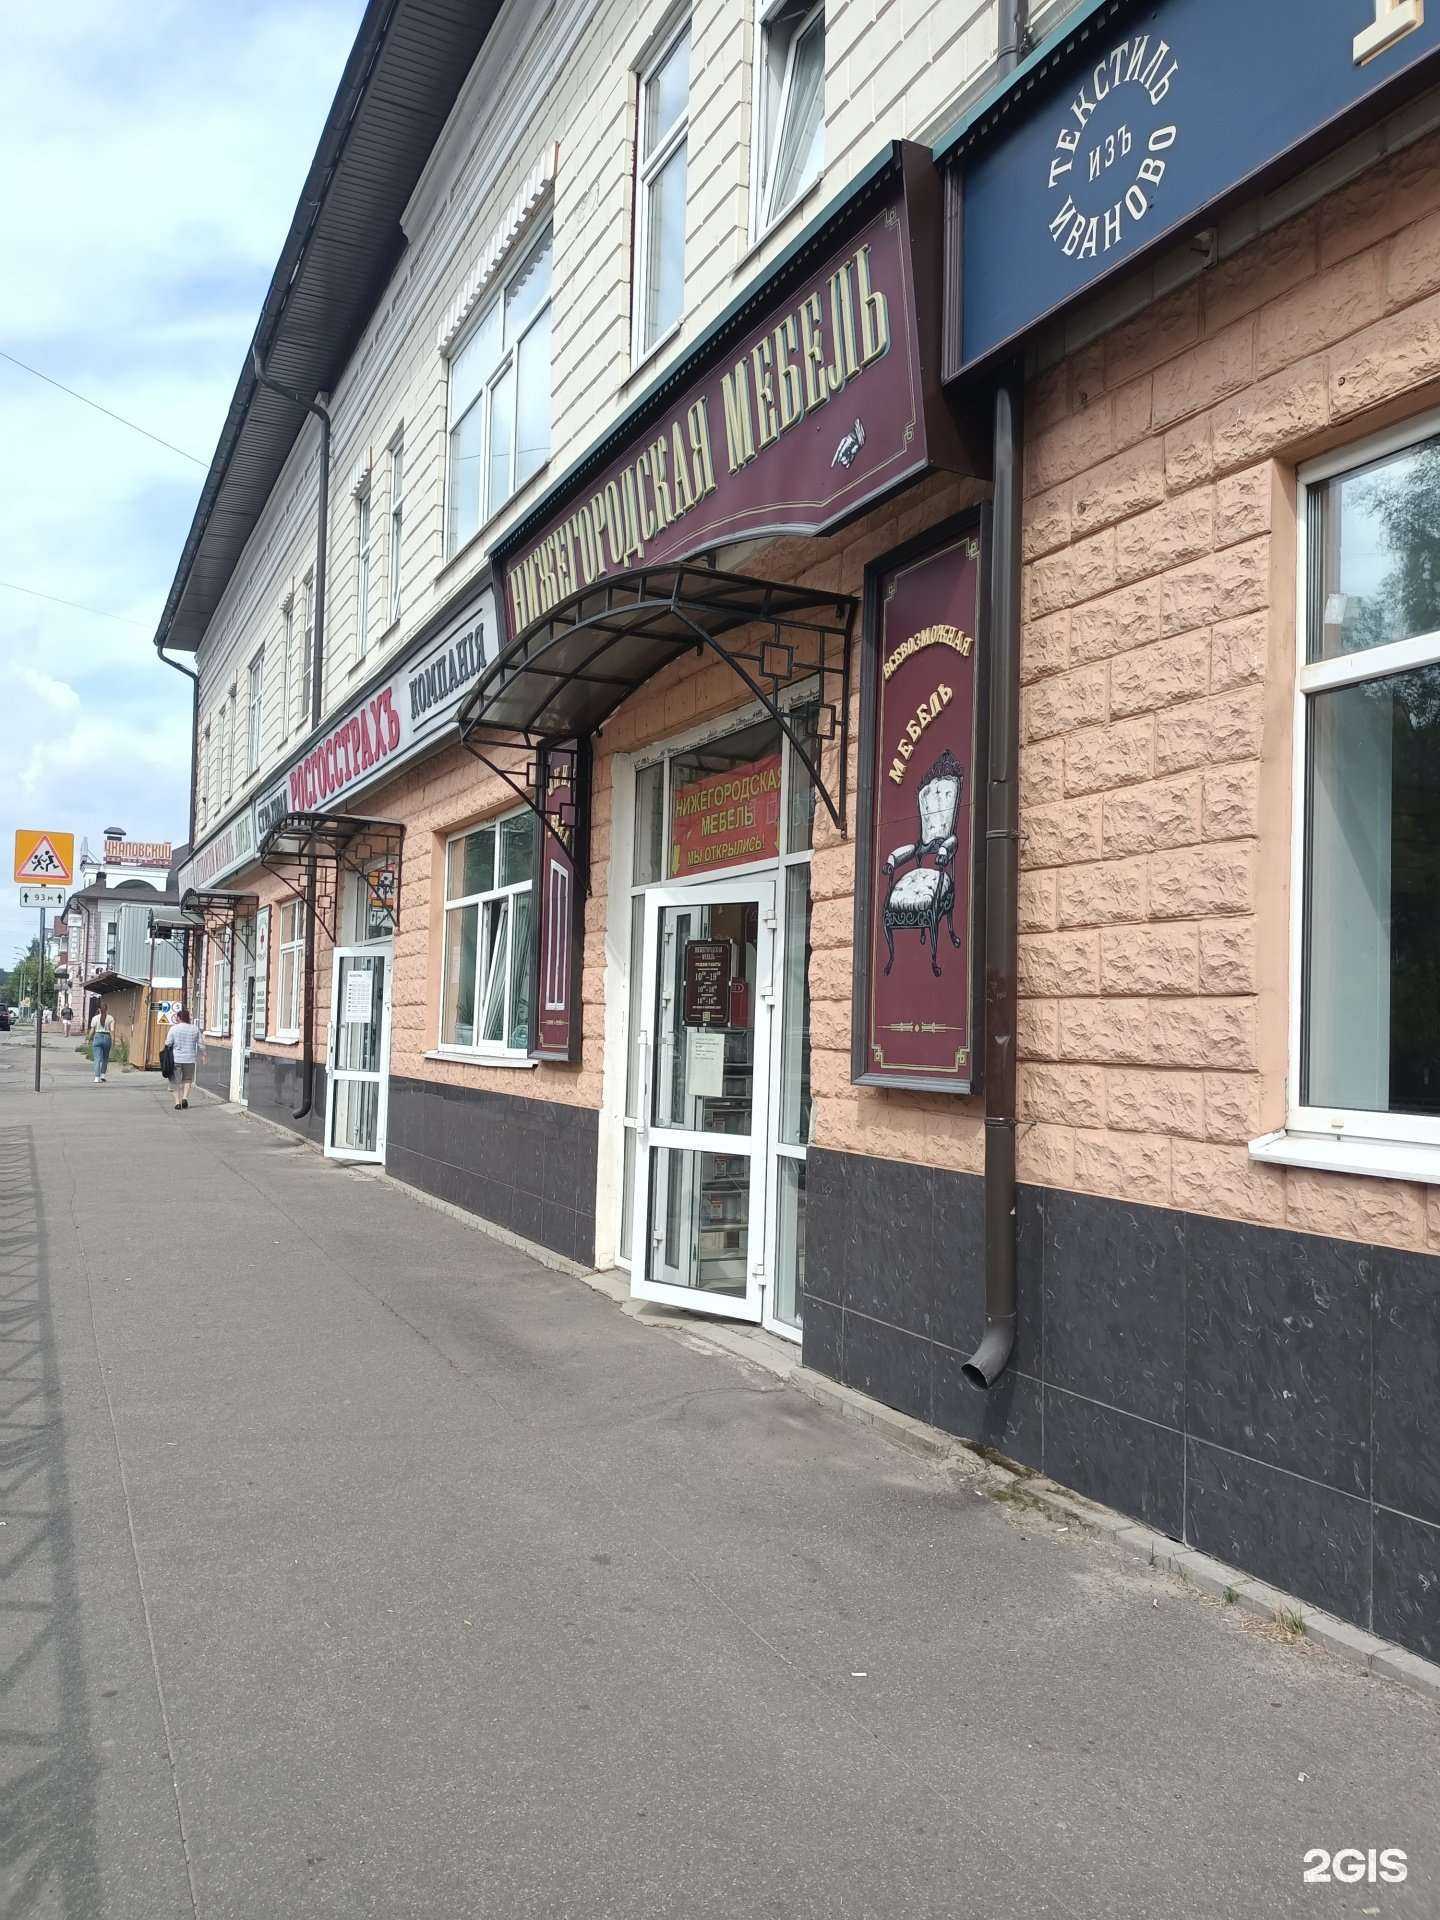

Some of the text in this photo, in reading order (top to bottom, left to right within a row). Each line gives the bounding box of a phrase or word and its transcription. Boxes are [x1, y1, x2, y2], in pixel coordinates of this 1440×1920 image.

[1048, 34, 1179, 188] ТЕКСТИЛЬ
[1088, 123, 1132, 183] ИЗЪ
[1048, 123, 1177, 260] ИВАНОВО
[510, 243, 891, 636] НИЖЕГОРОДСКАЯ МЕБЕЛЬ
[884, 624, 974, 680] ВСЕВОЗМОЖНАЯ
[289, 686, 400, 812] РОСГОССТРАХЪ
[889, 683, 953, 785] МЕБЕЛЬ
[688, 850, 703, 866] МЫ
[702, 804, 753, 837] МЕБЕЛЬ
